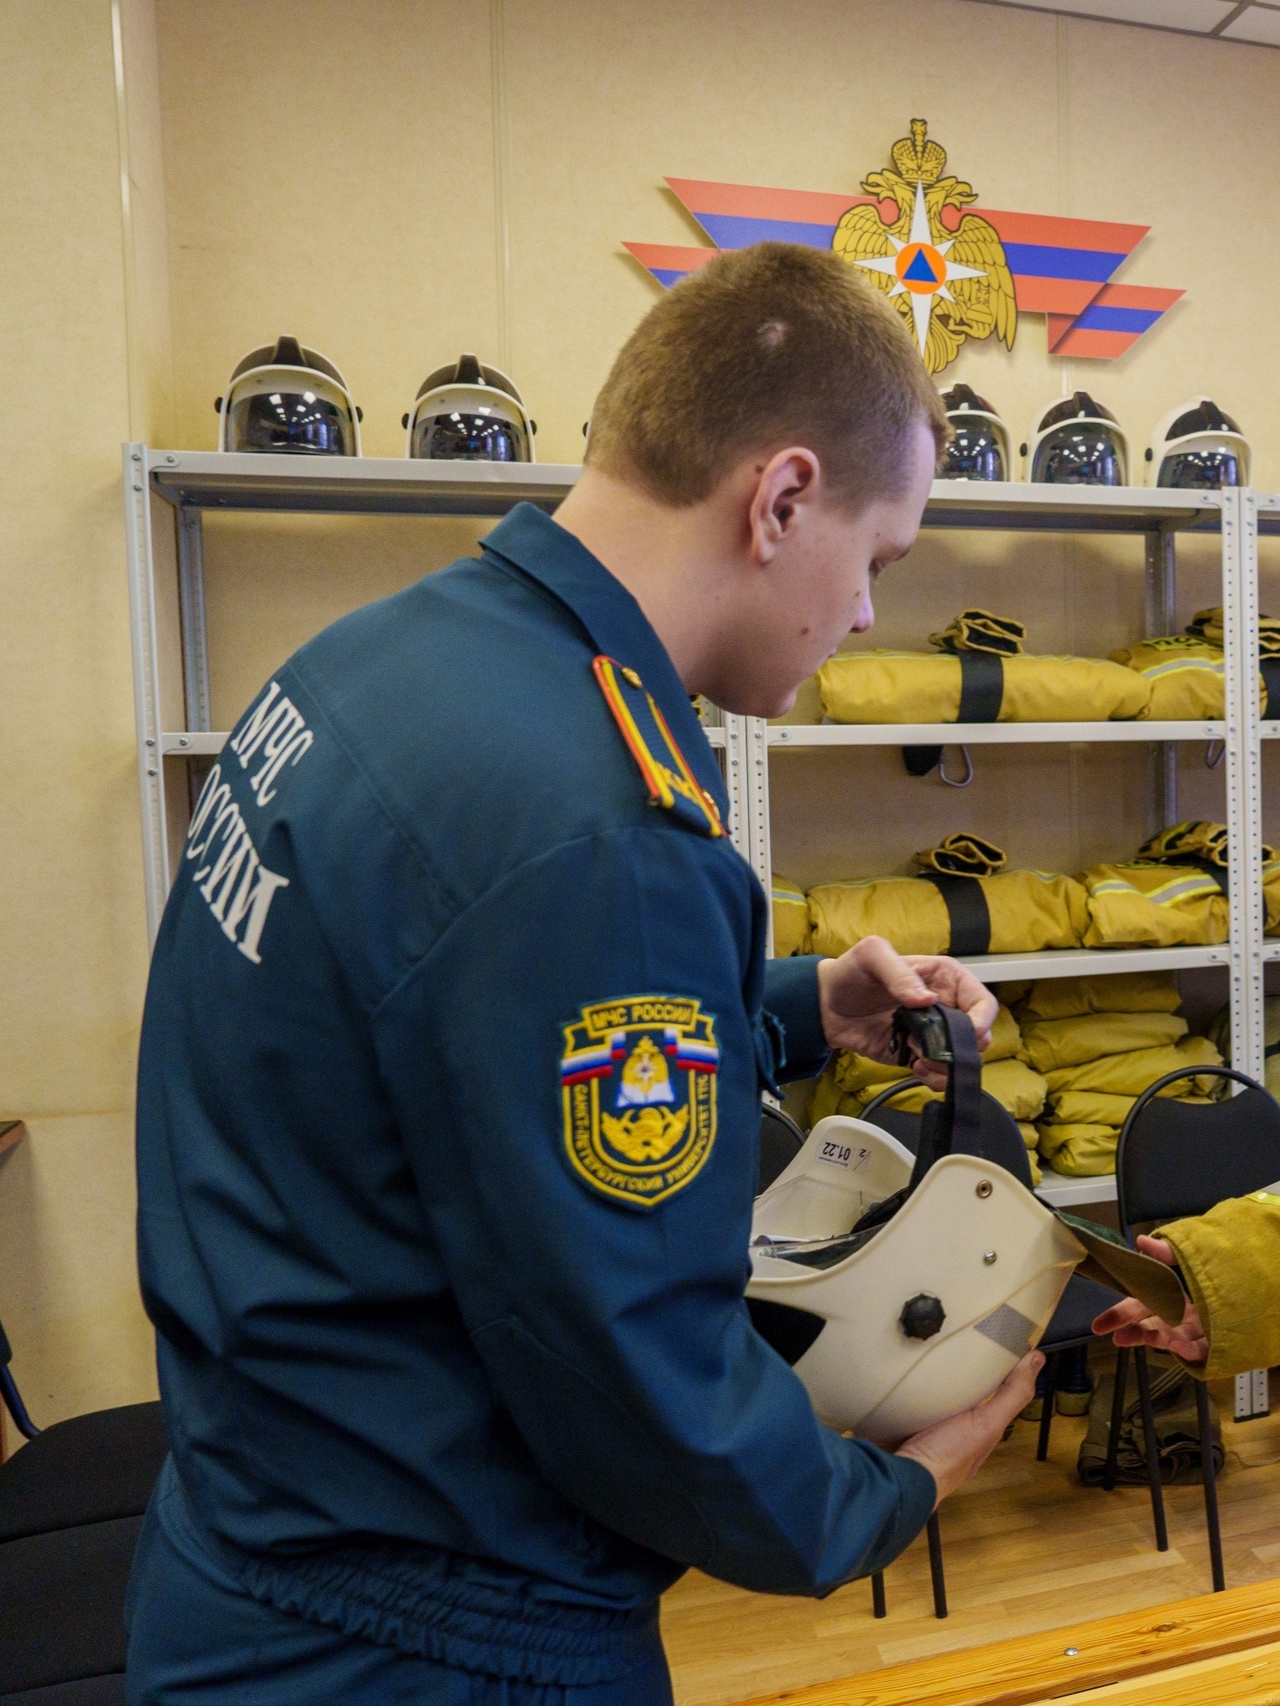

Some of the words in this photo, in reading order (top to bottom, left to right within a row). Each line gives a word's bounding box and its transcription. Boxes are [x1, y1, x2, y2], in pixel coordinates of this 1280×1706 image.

[230, 681, 314, 807] МЧС
[187, 763, 290, 965] ОССИИ
[591, 1007, 628, 1029] МЧС
[631, 1004, 692, 1024] РОССИИ
[822, 1141, 851, 1161] 01.22
